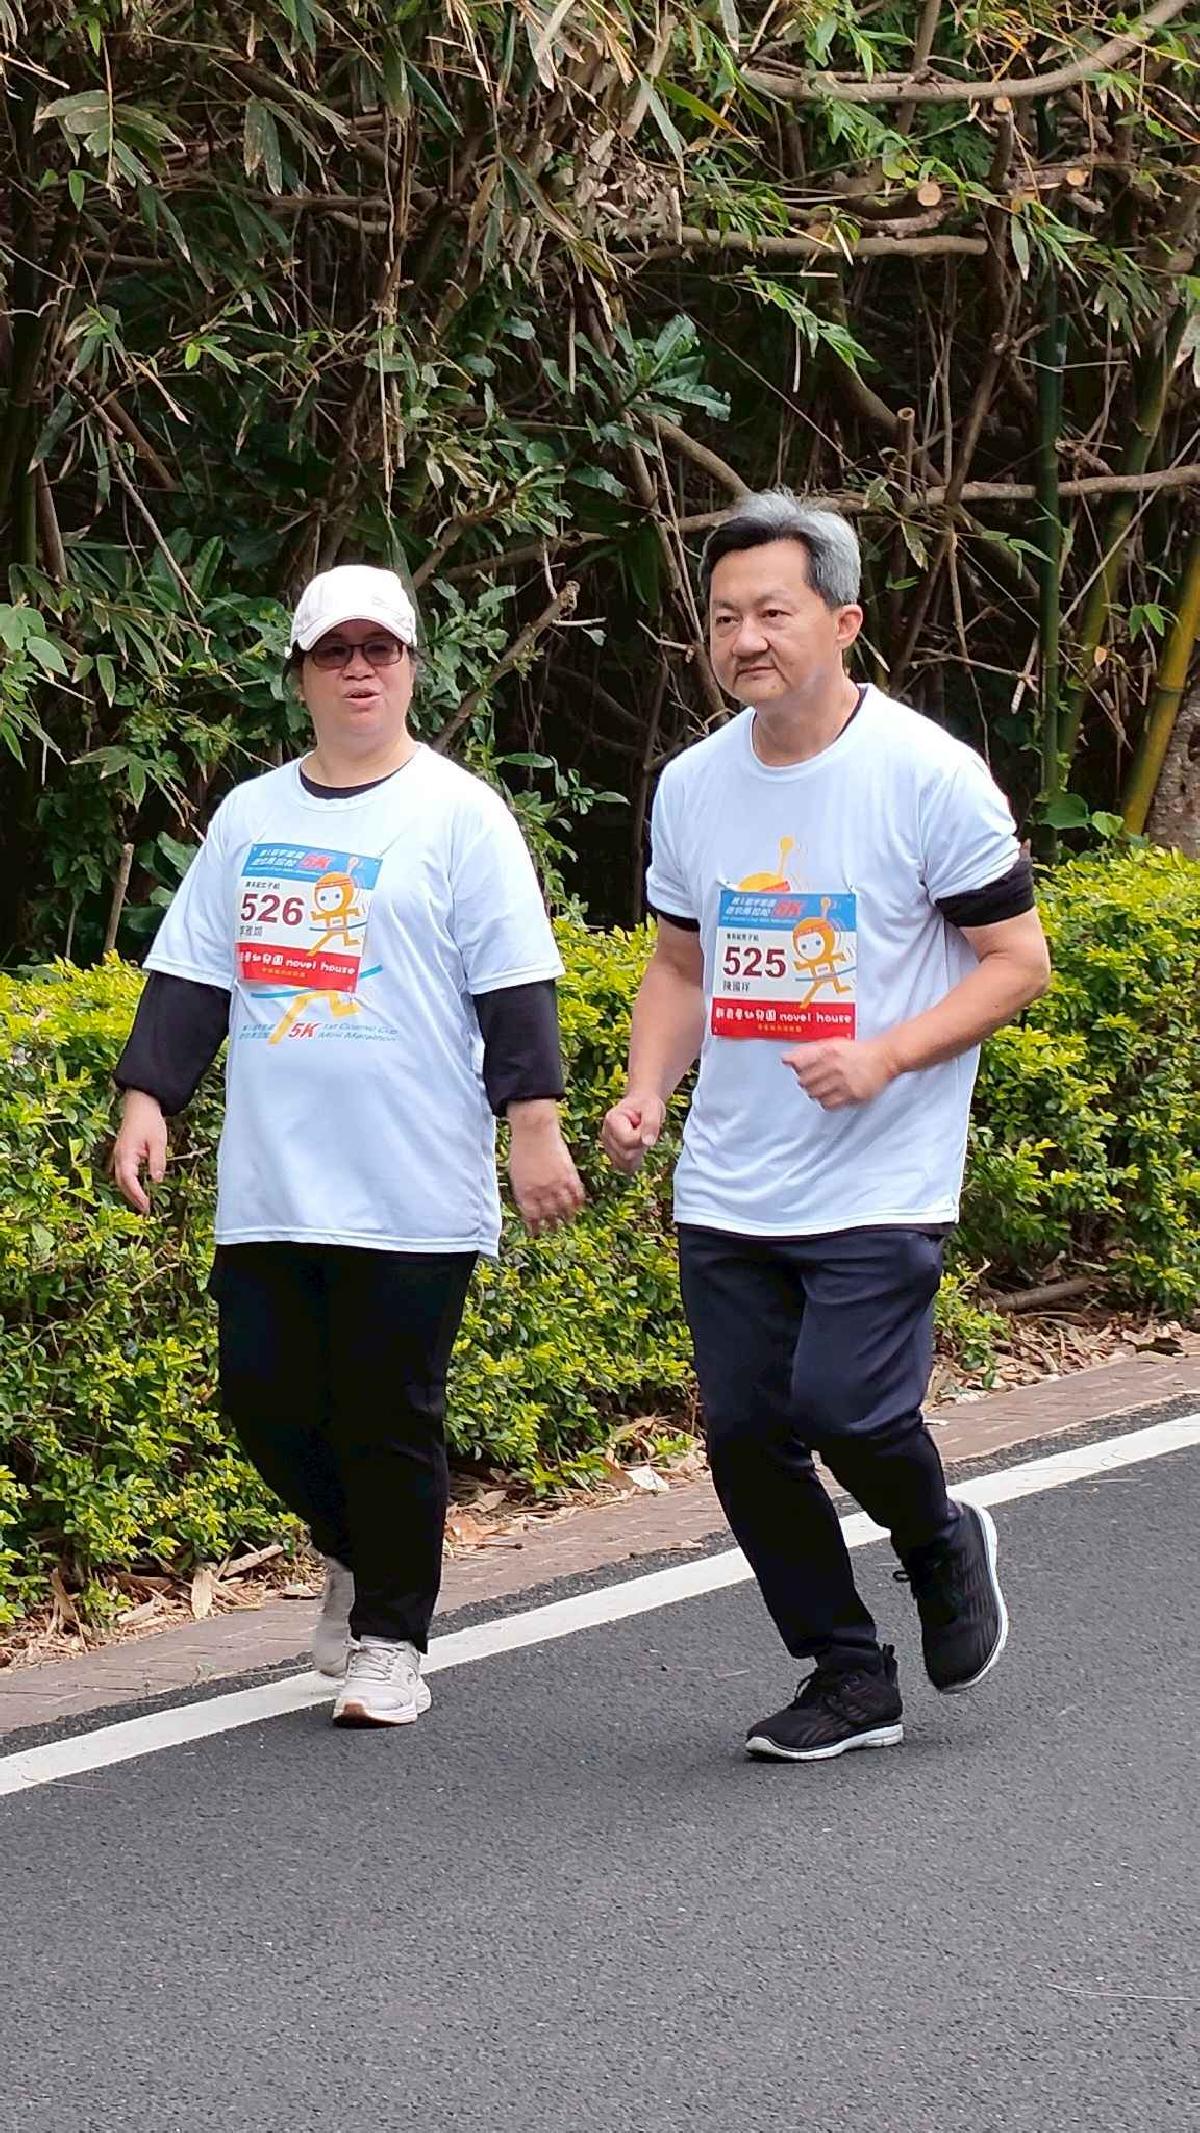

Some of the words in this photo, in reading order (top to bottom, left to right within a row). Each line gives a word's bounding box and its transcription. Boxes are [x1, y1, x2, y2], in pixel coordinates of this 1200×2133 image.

[240, 893, 304, 926] 526
[285, 959, 317, 970] novel
[320, 961, 355, 974] house
[723, 946, 786, 978] 525
[780, 1012, 811, 1023] novel
[816, 1012, 852, 1024] house
[288, 1023, 323, 1038] 5K
